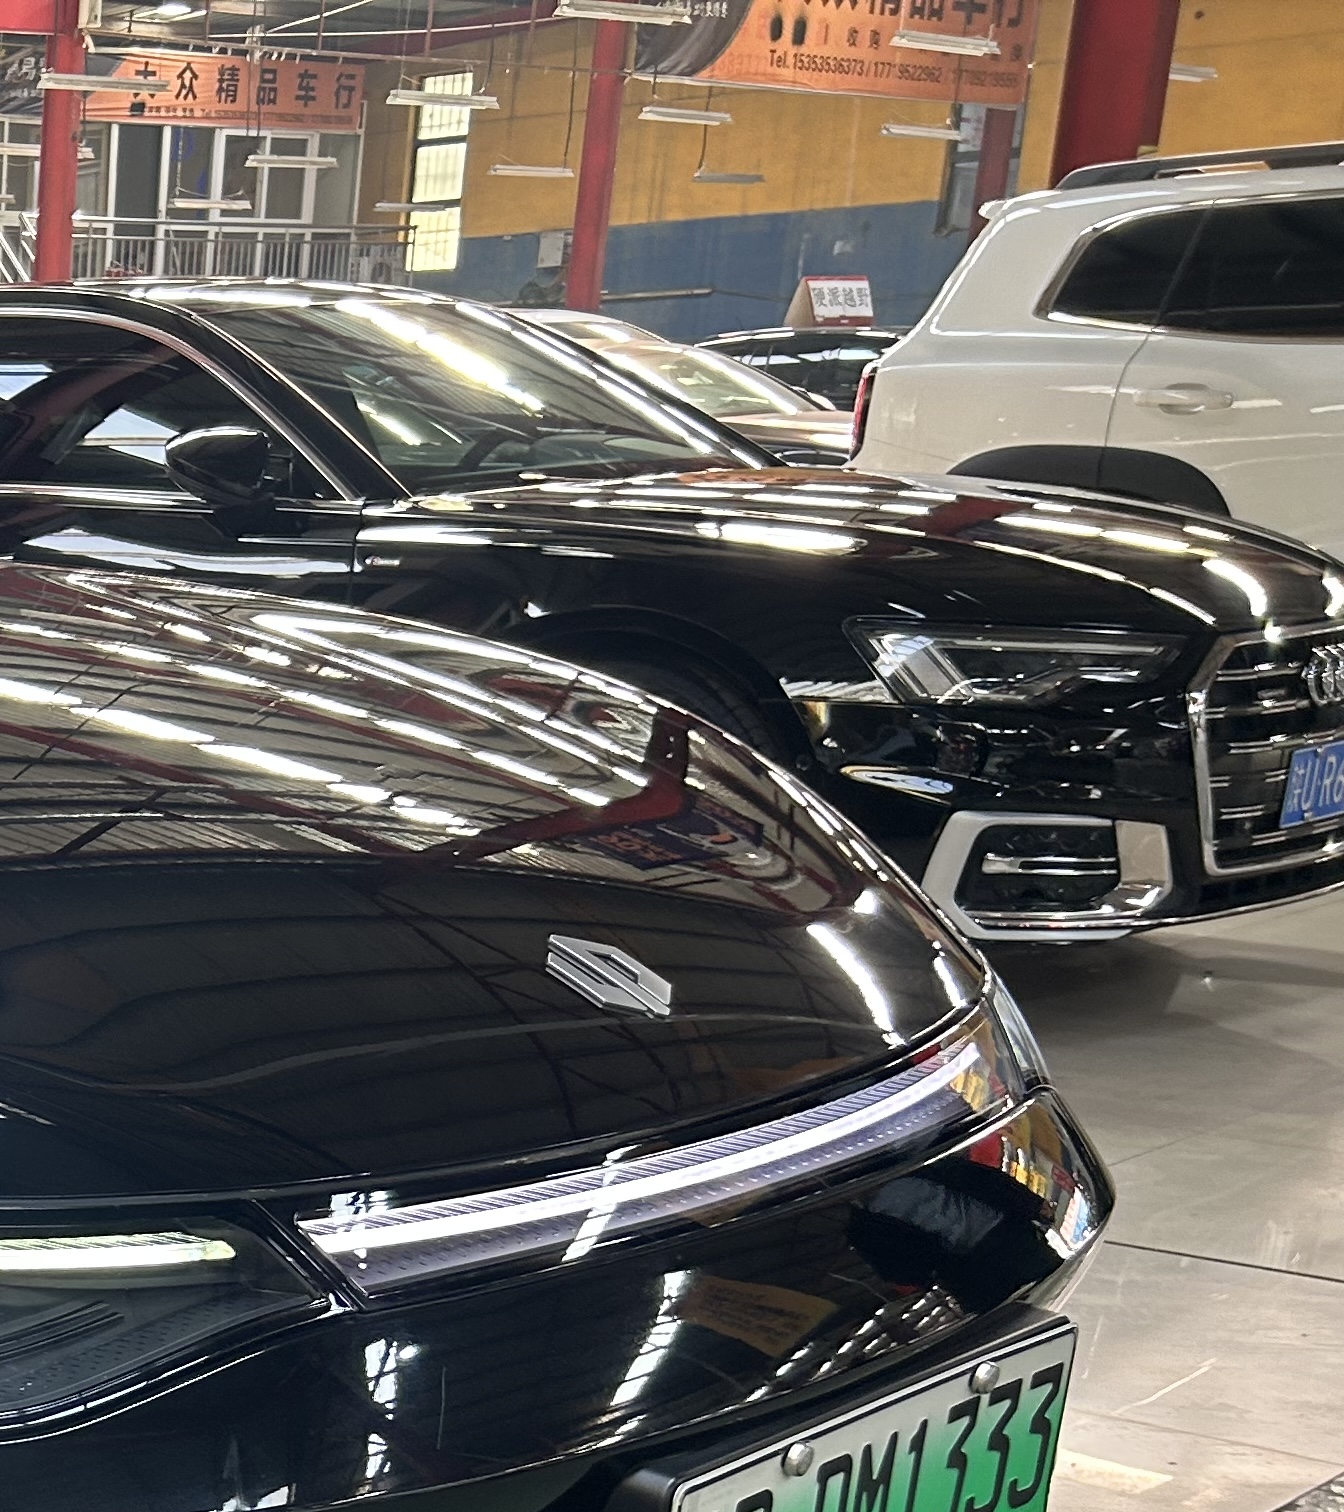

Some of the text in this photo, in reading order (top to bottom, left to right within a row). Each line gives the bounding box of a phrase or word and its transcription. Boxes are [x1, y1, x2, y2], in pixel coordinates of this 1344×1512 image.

[134, 61, 357, 109] 大众精品车行
